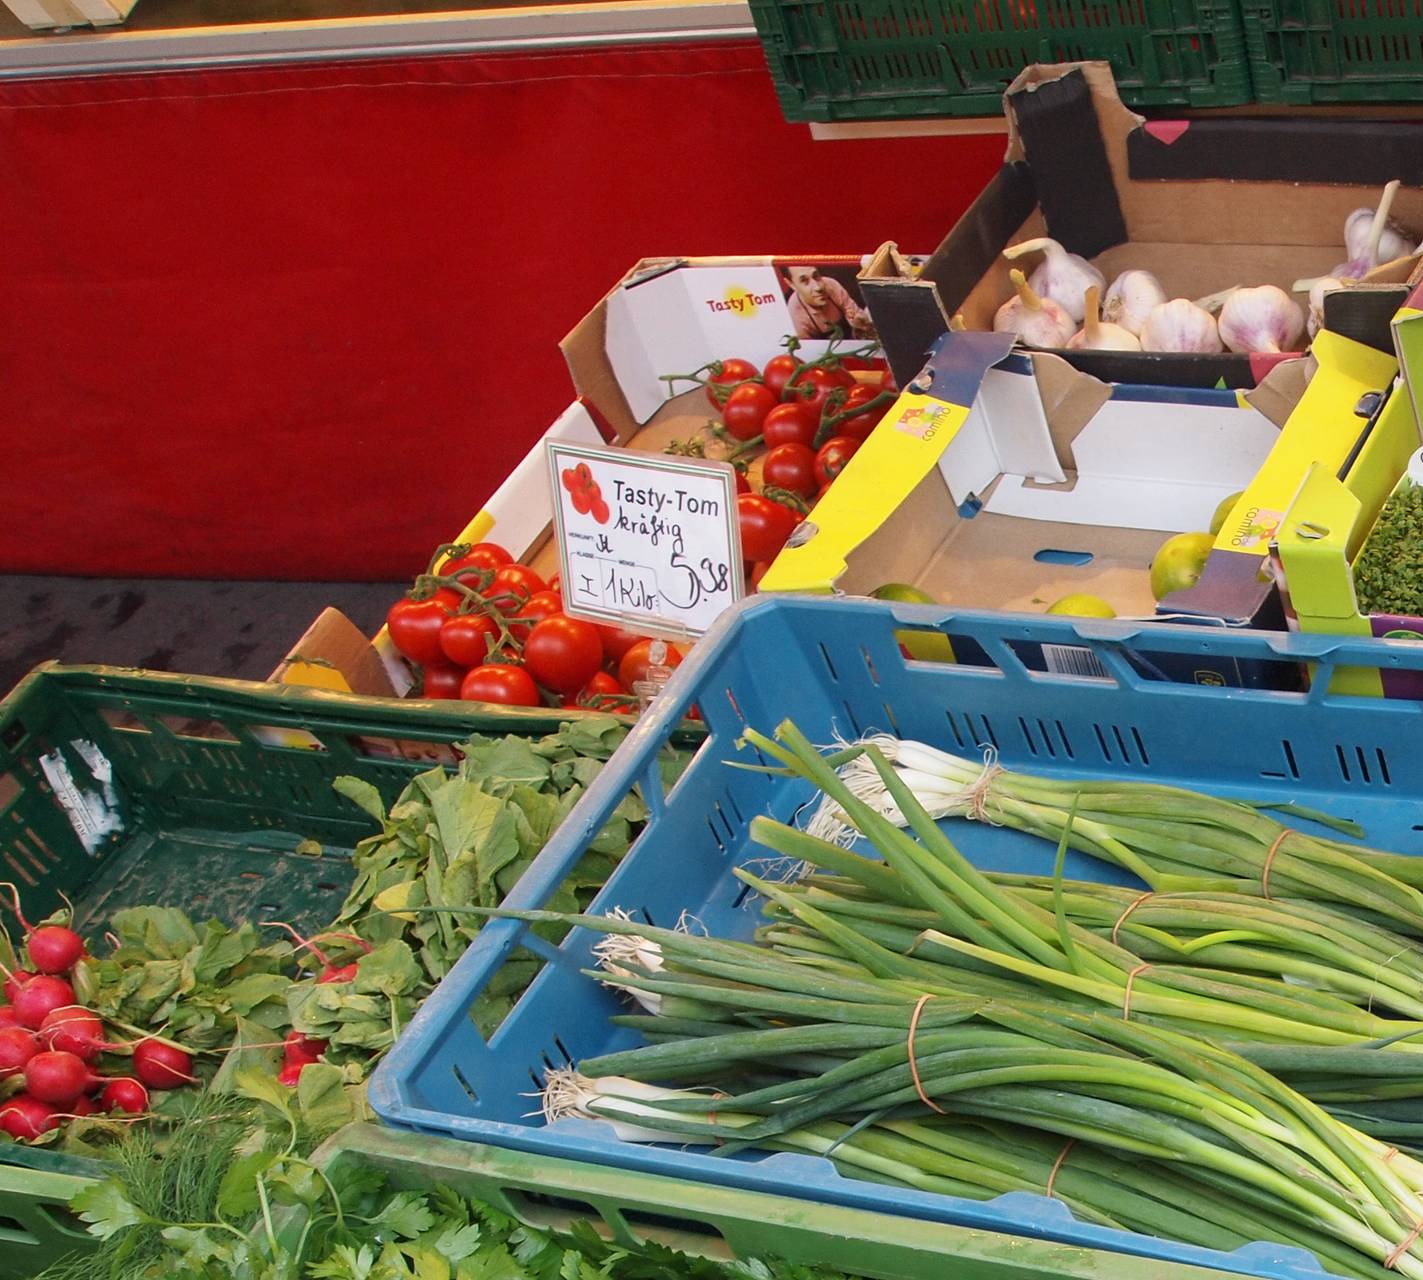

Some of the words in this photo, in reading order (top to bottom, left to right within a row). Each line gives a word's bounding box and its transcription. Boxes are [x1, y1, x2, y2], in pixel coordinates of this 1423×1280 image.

[706, 298, 744, 312] Tasty
[745, 293, 776, 307] Tom
[613, 480, 719, 517] Tasty-Tom
[614, 505, 684, 553] kräftig
